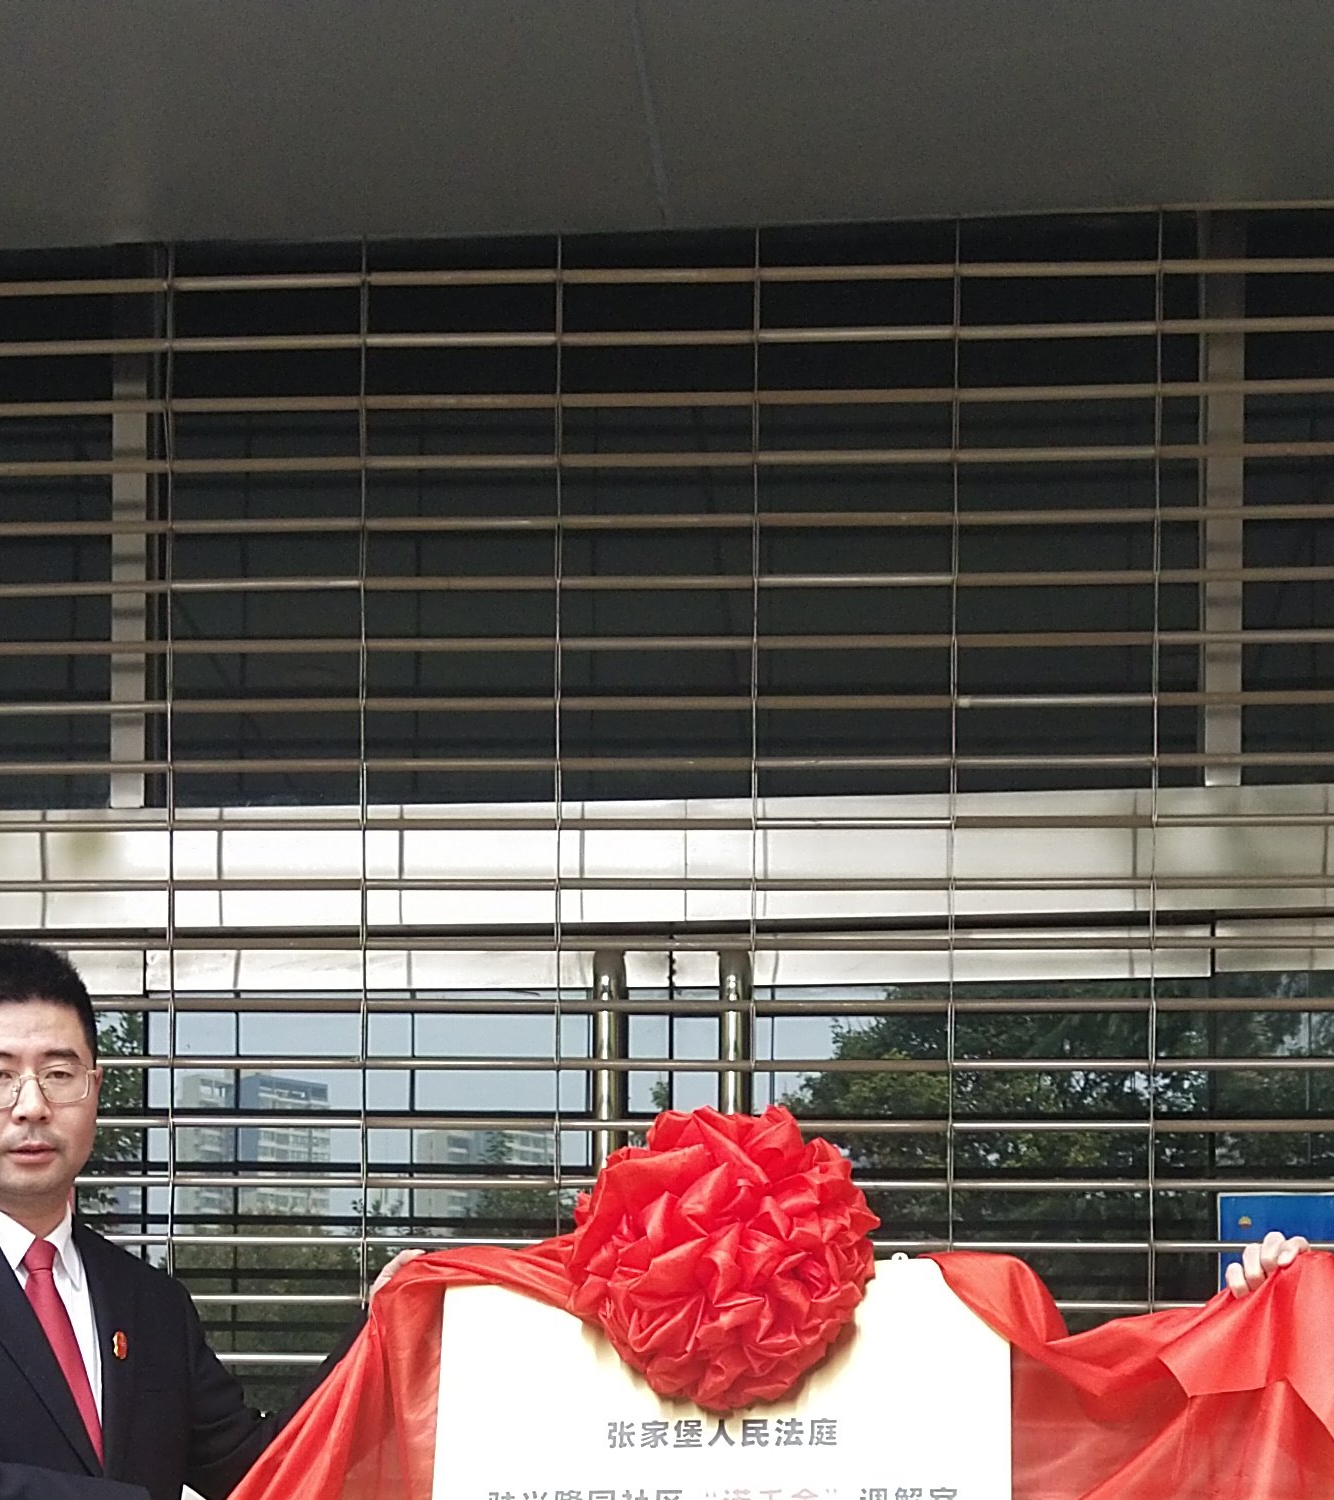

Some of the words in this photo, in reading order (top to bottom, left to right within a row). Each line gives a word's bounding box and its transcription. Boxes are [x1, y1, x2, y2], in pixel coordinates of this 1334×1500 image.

[607, 1418, 838, 1449] 张家堡人民法庭
